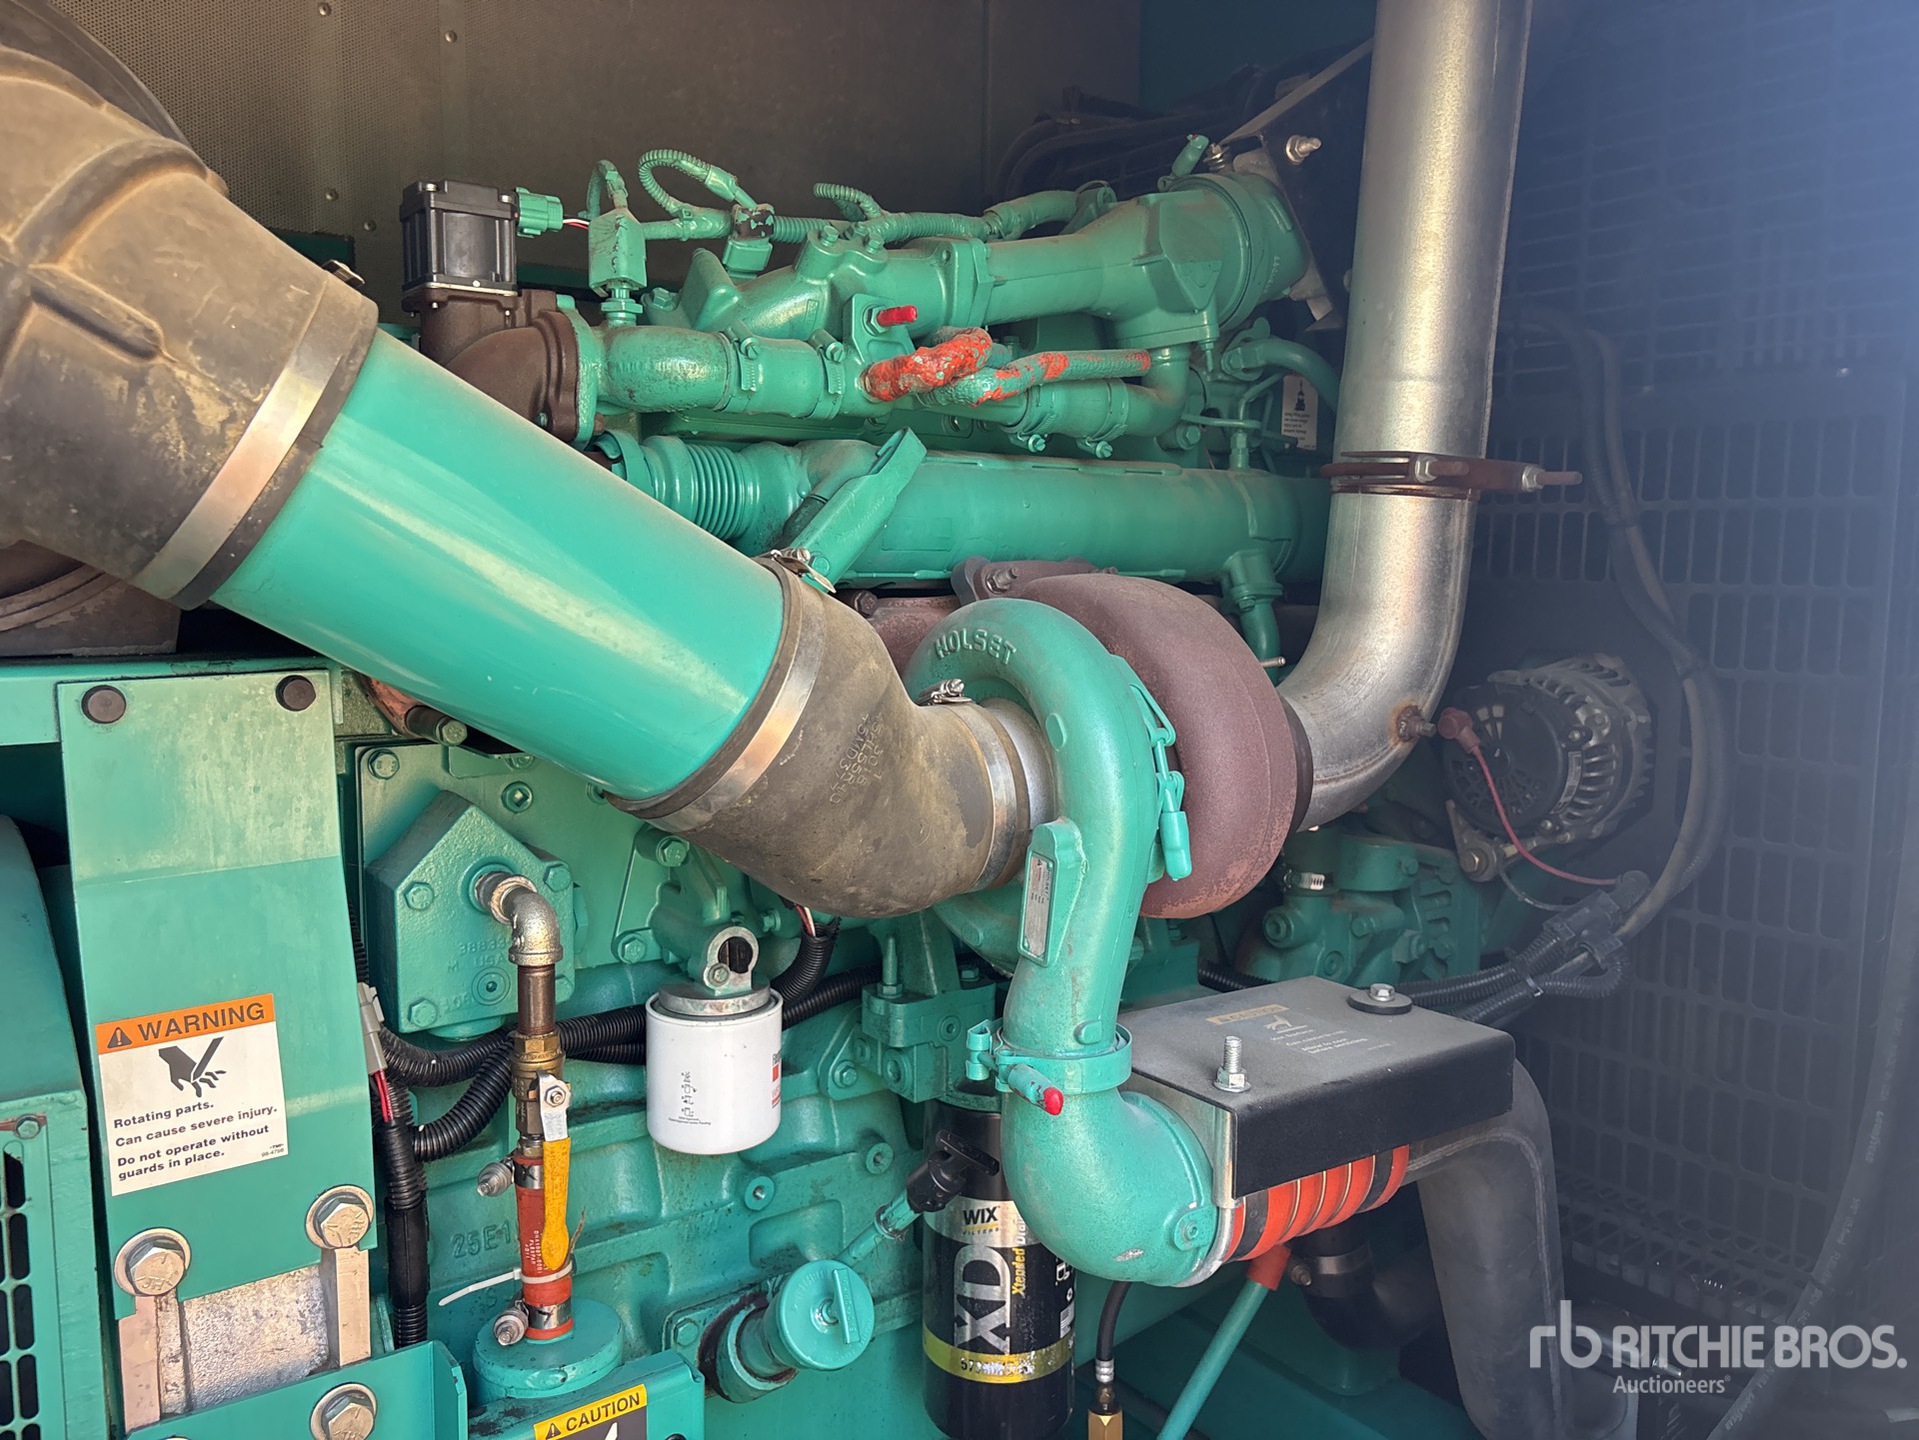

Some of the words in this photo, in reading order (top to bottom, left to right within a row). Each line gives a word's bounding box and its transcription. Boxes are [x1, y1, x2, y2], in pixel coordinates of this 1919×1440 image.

[934, 627, 1017, 665] HOLSET
[137, 1002, 265, 1041] WARNING
[113, 1109, 172, 1129] Rotating
[176, 1101, 214, 1122] parts.
[115, 1135, 142, 1147] Can
[146, 1125, 186, 1141] cause
[190, 1114, 234, 1131] severe
[238, 1104, 278, 1122] injury.
[117, 1155, 135, 1167] Do
[140, 1150, 161, 1162] not
[165, 1138, 217, 1157] operate
[221, 1124, 269, 1143] without
[118, 1163, 164, 1181] guards
[168, 1158, 181, 1168] in
[185, 1149, 225, 1166] place.
[963, 1206, 998, 1225] WIX
[1012, 1247, 1026, 1295] Xtended
[954, 1245, 1011, 1356] XD
[566, 1392, 640, 1432] CAUTION
